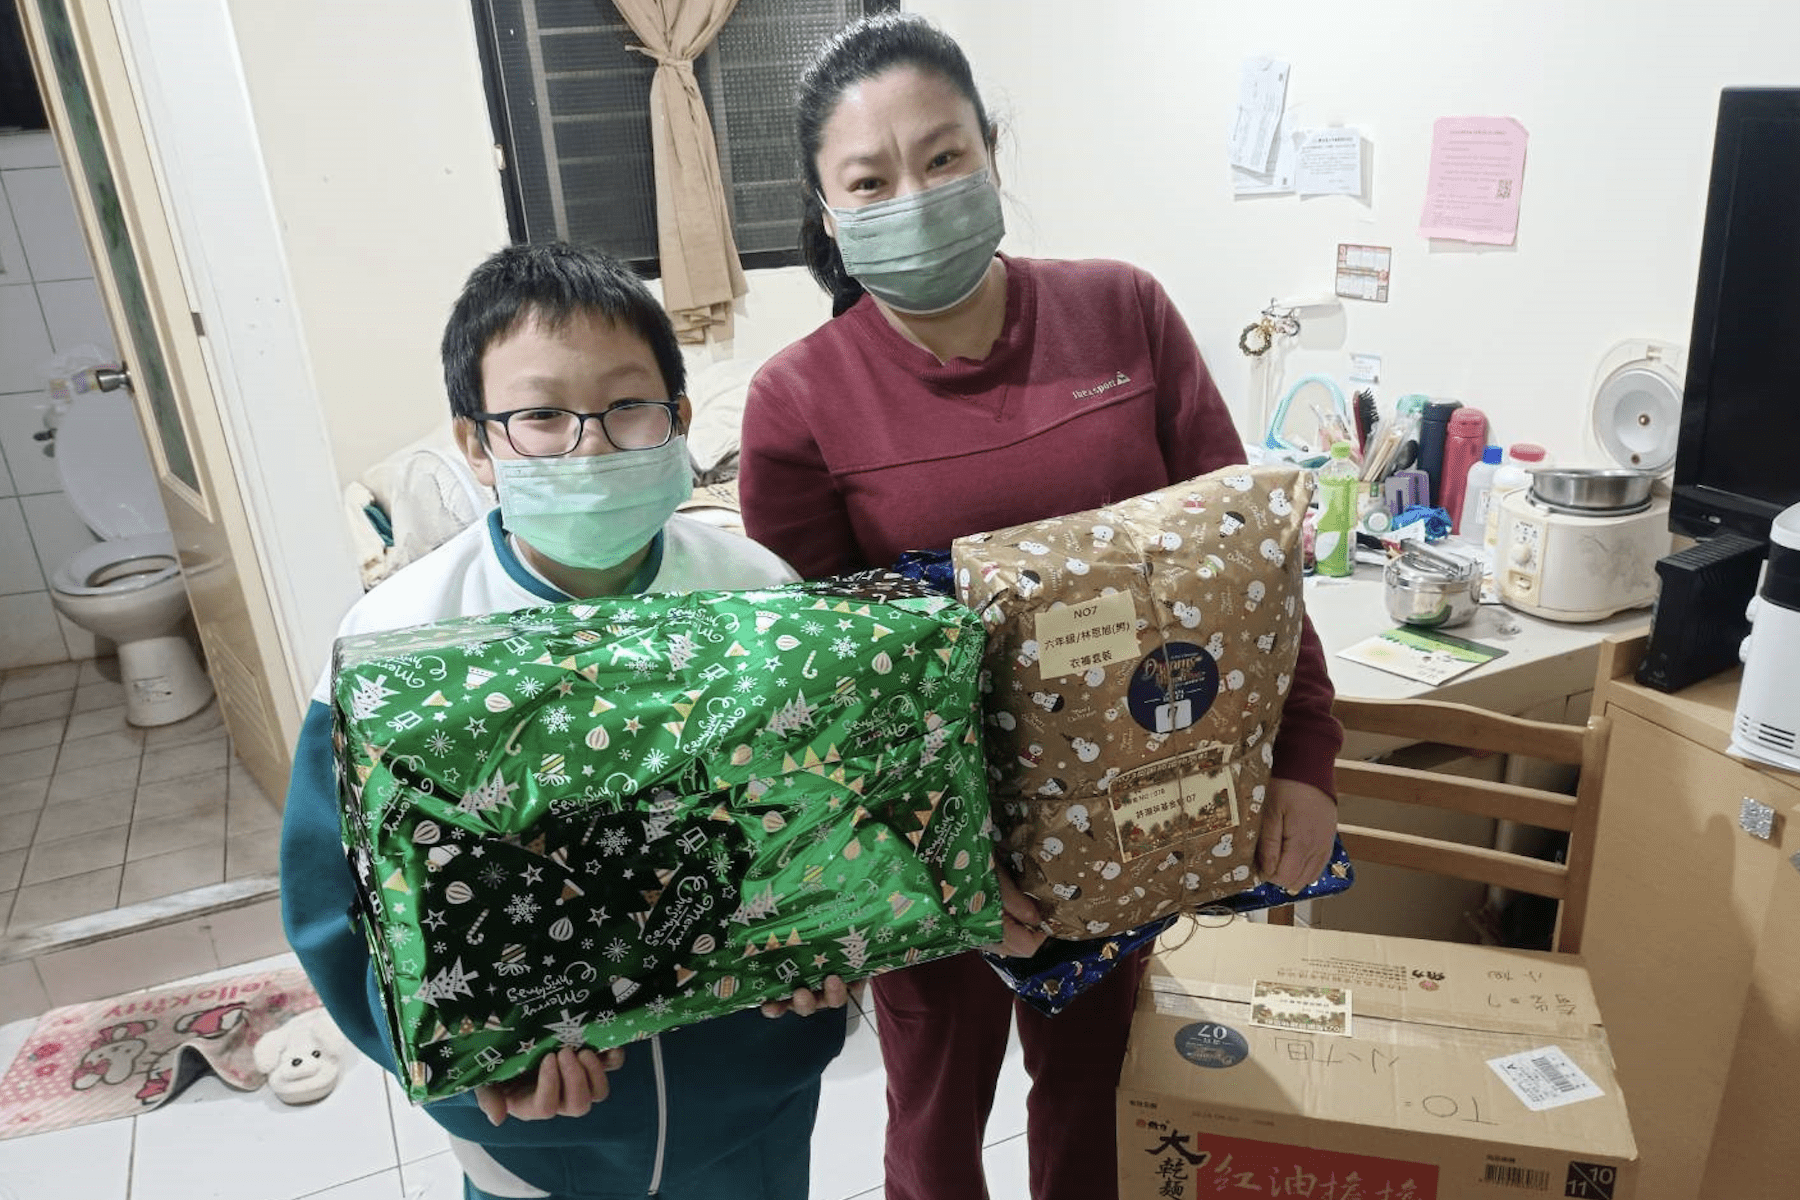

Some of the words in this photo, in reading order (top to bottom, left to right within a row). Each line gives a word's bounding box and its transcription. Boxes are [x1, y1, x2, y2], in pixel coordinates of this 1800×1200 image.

[1074, 606, 1097, 619] NO7
[1197, 1023, 1228, 1038] 07
[1589, 1167, 1614, 1185] 10
[1567, 1180, 1588, 1196] 11
